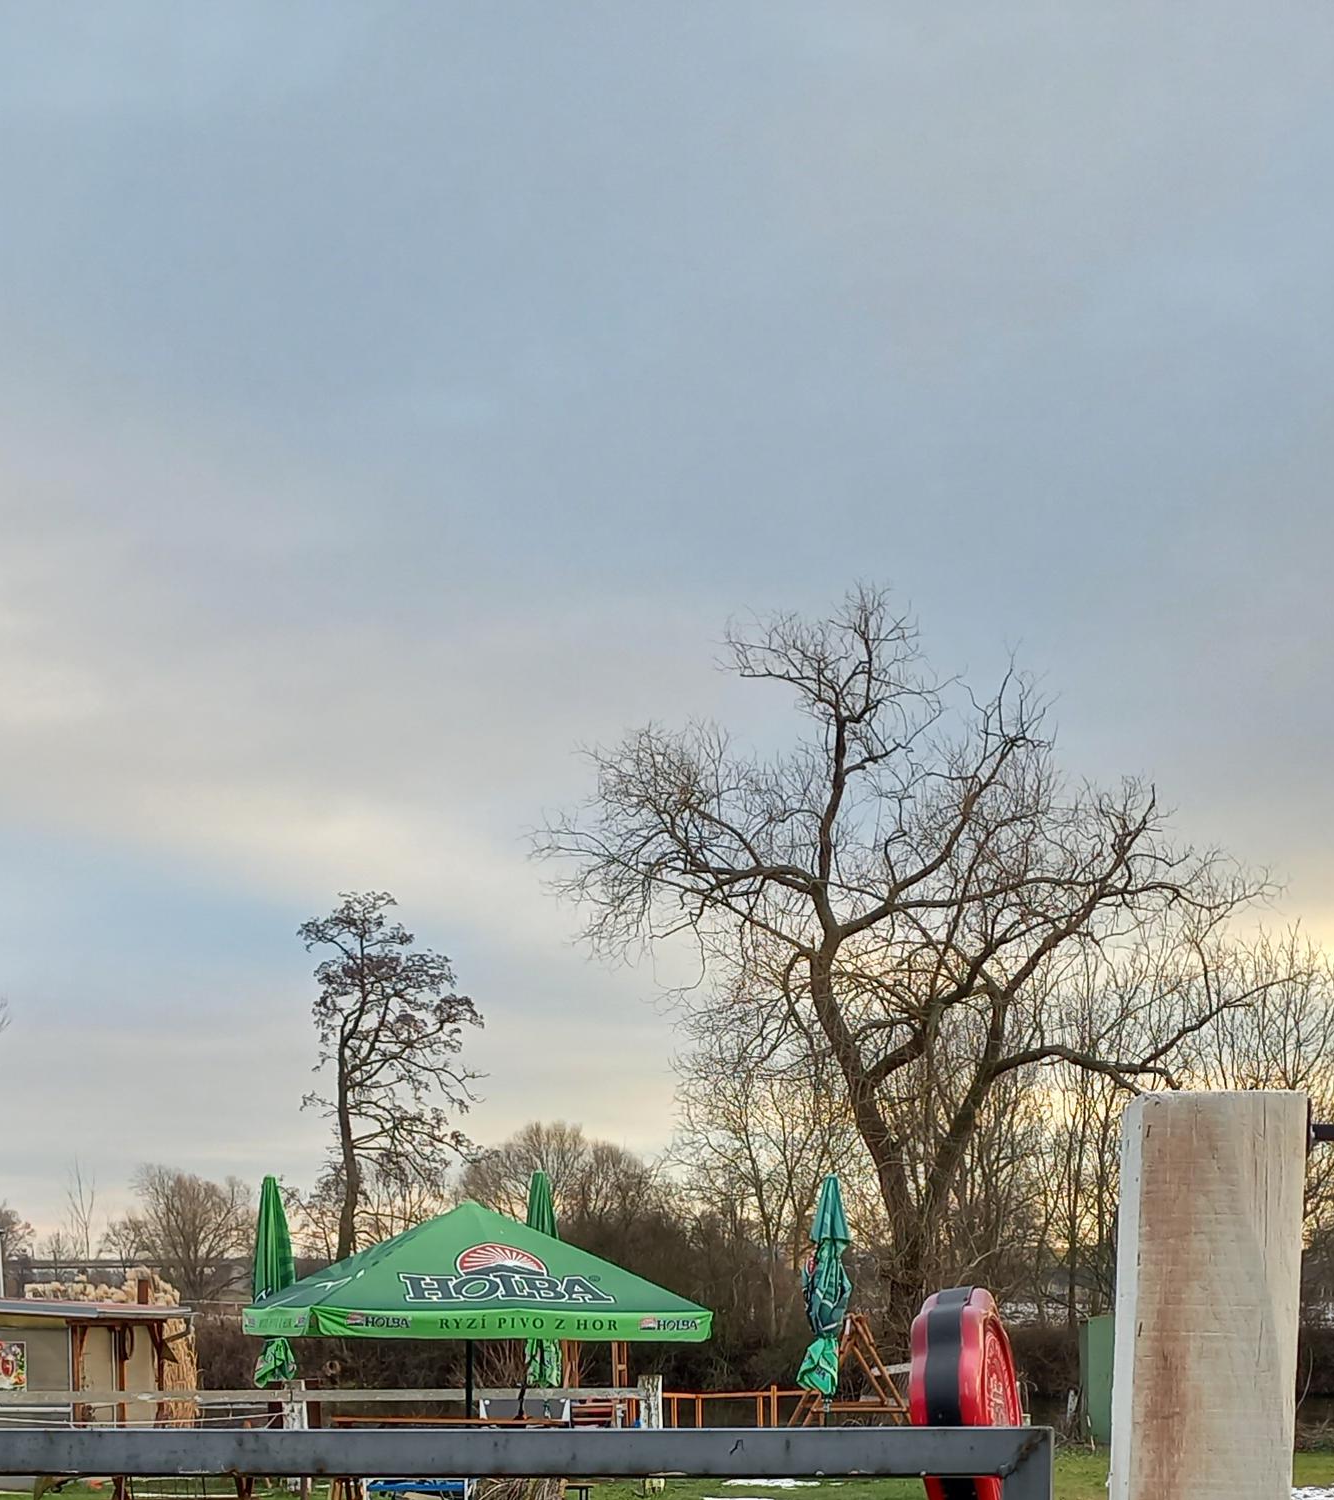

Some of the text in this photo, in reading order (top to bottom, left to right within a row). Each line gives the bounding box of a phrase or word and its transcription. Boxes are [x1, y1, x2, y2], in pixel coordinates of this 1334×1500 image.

[399, 1271, 616, 1304] HOLBA
[365, 1316, 410, 1329] HOLBA
[438, 1314, 619, 1332] RYZÍ PIVO Z HOR
[656, 1319, 700, 1332] HOLBA
